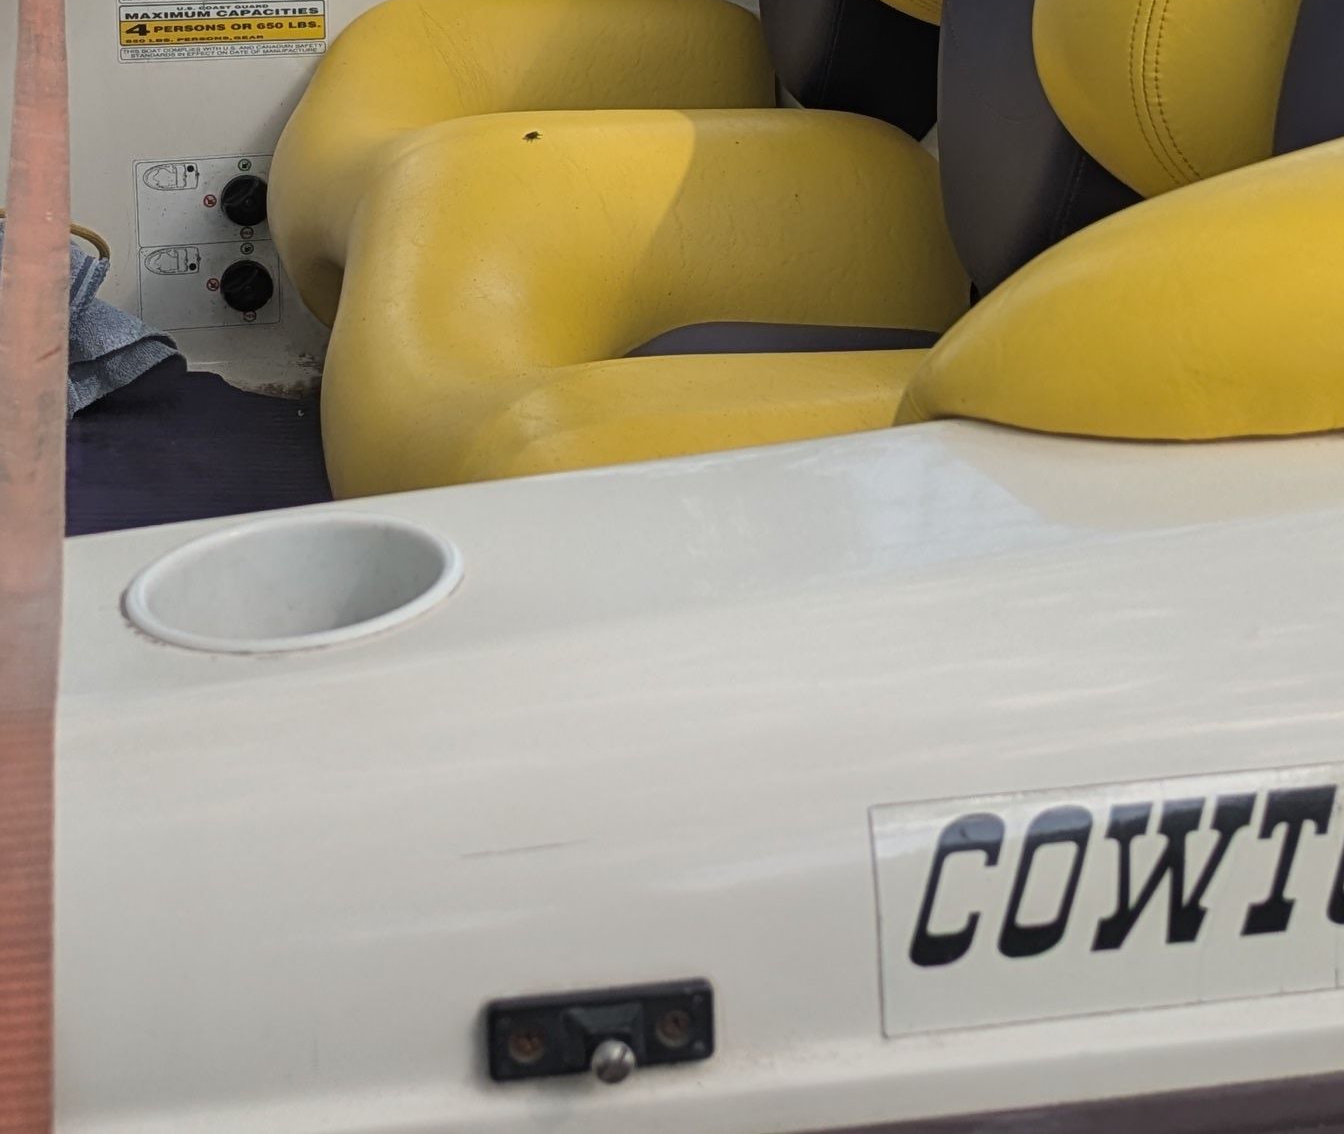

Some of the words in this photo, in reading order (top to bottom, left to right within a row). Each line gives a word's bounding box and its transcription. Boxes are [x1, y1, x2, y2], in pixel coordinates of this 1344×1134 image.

[125, 11, 210, 19] MAXIMUM
[217, 8, 319, 17] CAPACITIES
[126, 24, 150, 36] 4
[154, 24, 225, 32] PERSONS
[289, 21, 321, 29] LBS.
